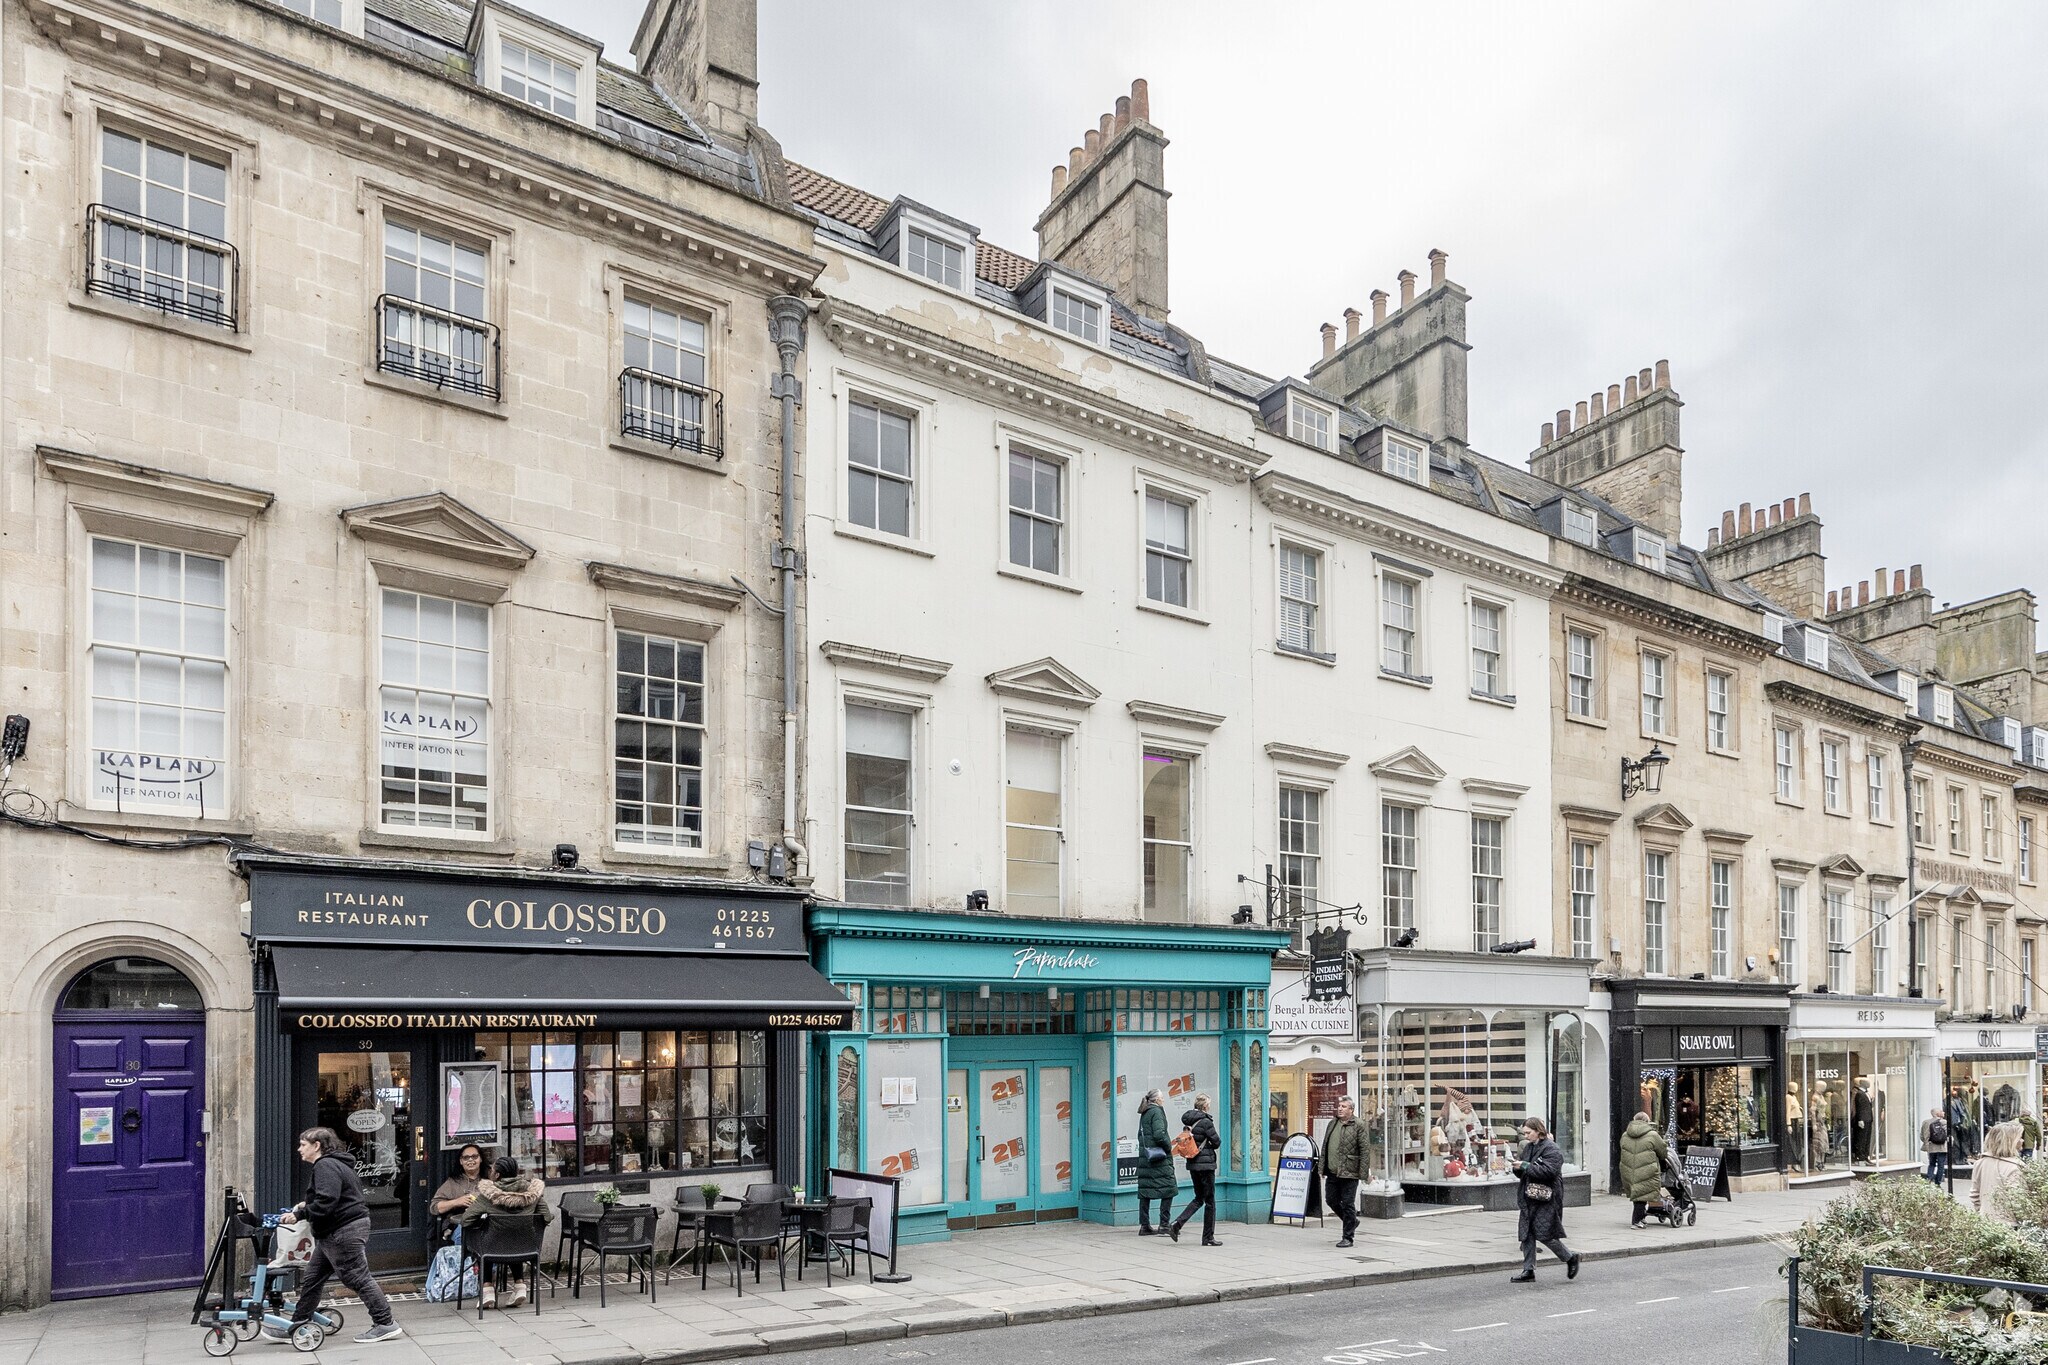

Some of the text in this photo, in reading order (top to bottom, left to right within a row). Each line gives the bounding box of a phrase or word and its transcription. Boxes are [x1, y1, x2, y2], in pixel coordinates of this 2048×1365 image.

[384, 711, 466, 732] KAPLAN
[100, 752, 202, 774] KAPLAN
[325, 892, 404, 906] ITALIAN
[298, 911, 429, 926] RESTAURANT
[466, 899, 666, 935] COLOSSEO
[717, 909, 770, 923] 01225
[712, 925, 775, 938] 461567
[1013, 946, 1100, 979] Paperchase
[1316, 965, 1342, 974] INDIAN
[1315, 973, 1343, 982] CUISINE
[1275, 1003, 1346, 1016] Bengal Brasserie
[1858, 1010, 1885, 1021] REISS
[298, 1014, 842, 1028] COLOSSEO ITALIAN RESTAURANT 01225 461567
[1271, 1020, 1349, 1030] INDIAN CUISINE
[358, 1040, 373, 1049] 30
[1680, 1035, 1735, 1049] SUAVE OWL
[126, 1060, 140, 1070] 30
[1886, 1066, 1906, 1075] REISS
[1816, 1069, 1839, 1079] REISS
[991, 1077, 1018, 1101] 21
[1168, 1075, 1191, 1097] 21
[992, 1139, 1019, 1164] 21
[881, 1151, 912, 1177] 21
[1685, 1155, 1719, 1166] HUSBAND
[1119, 1167, 1137, 1176] 0117
[1692, 1176, 1716, 1186] POINT
